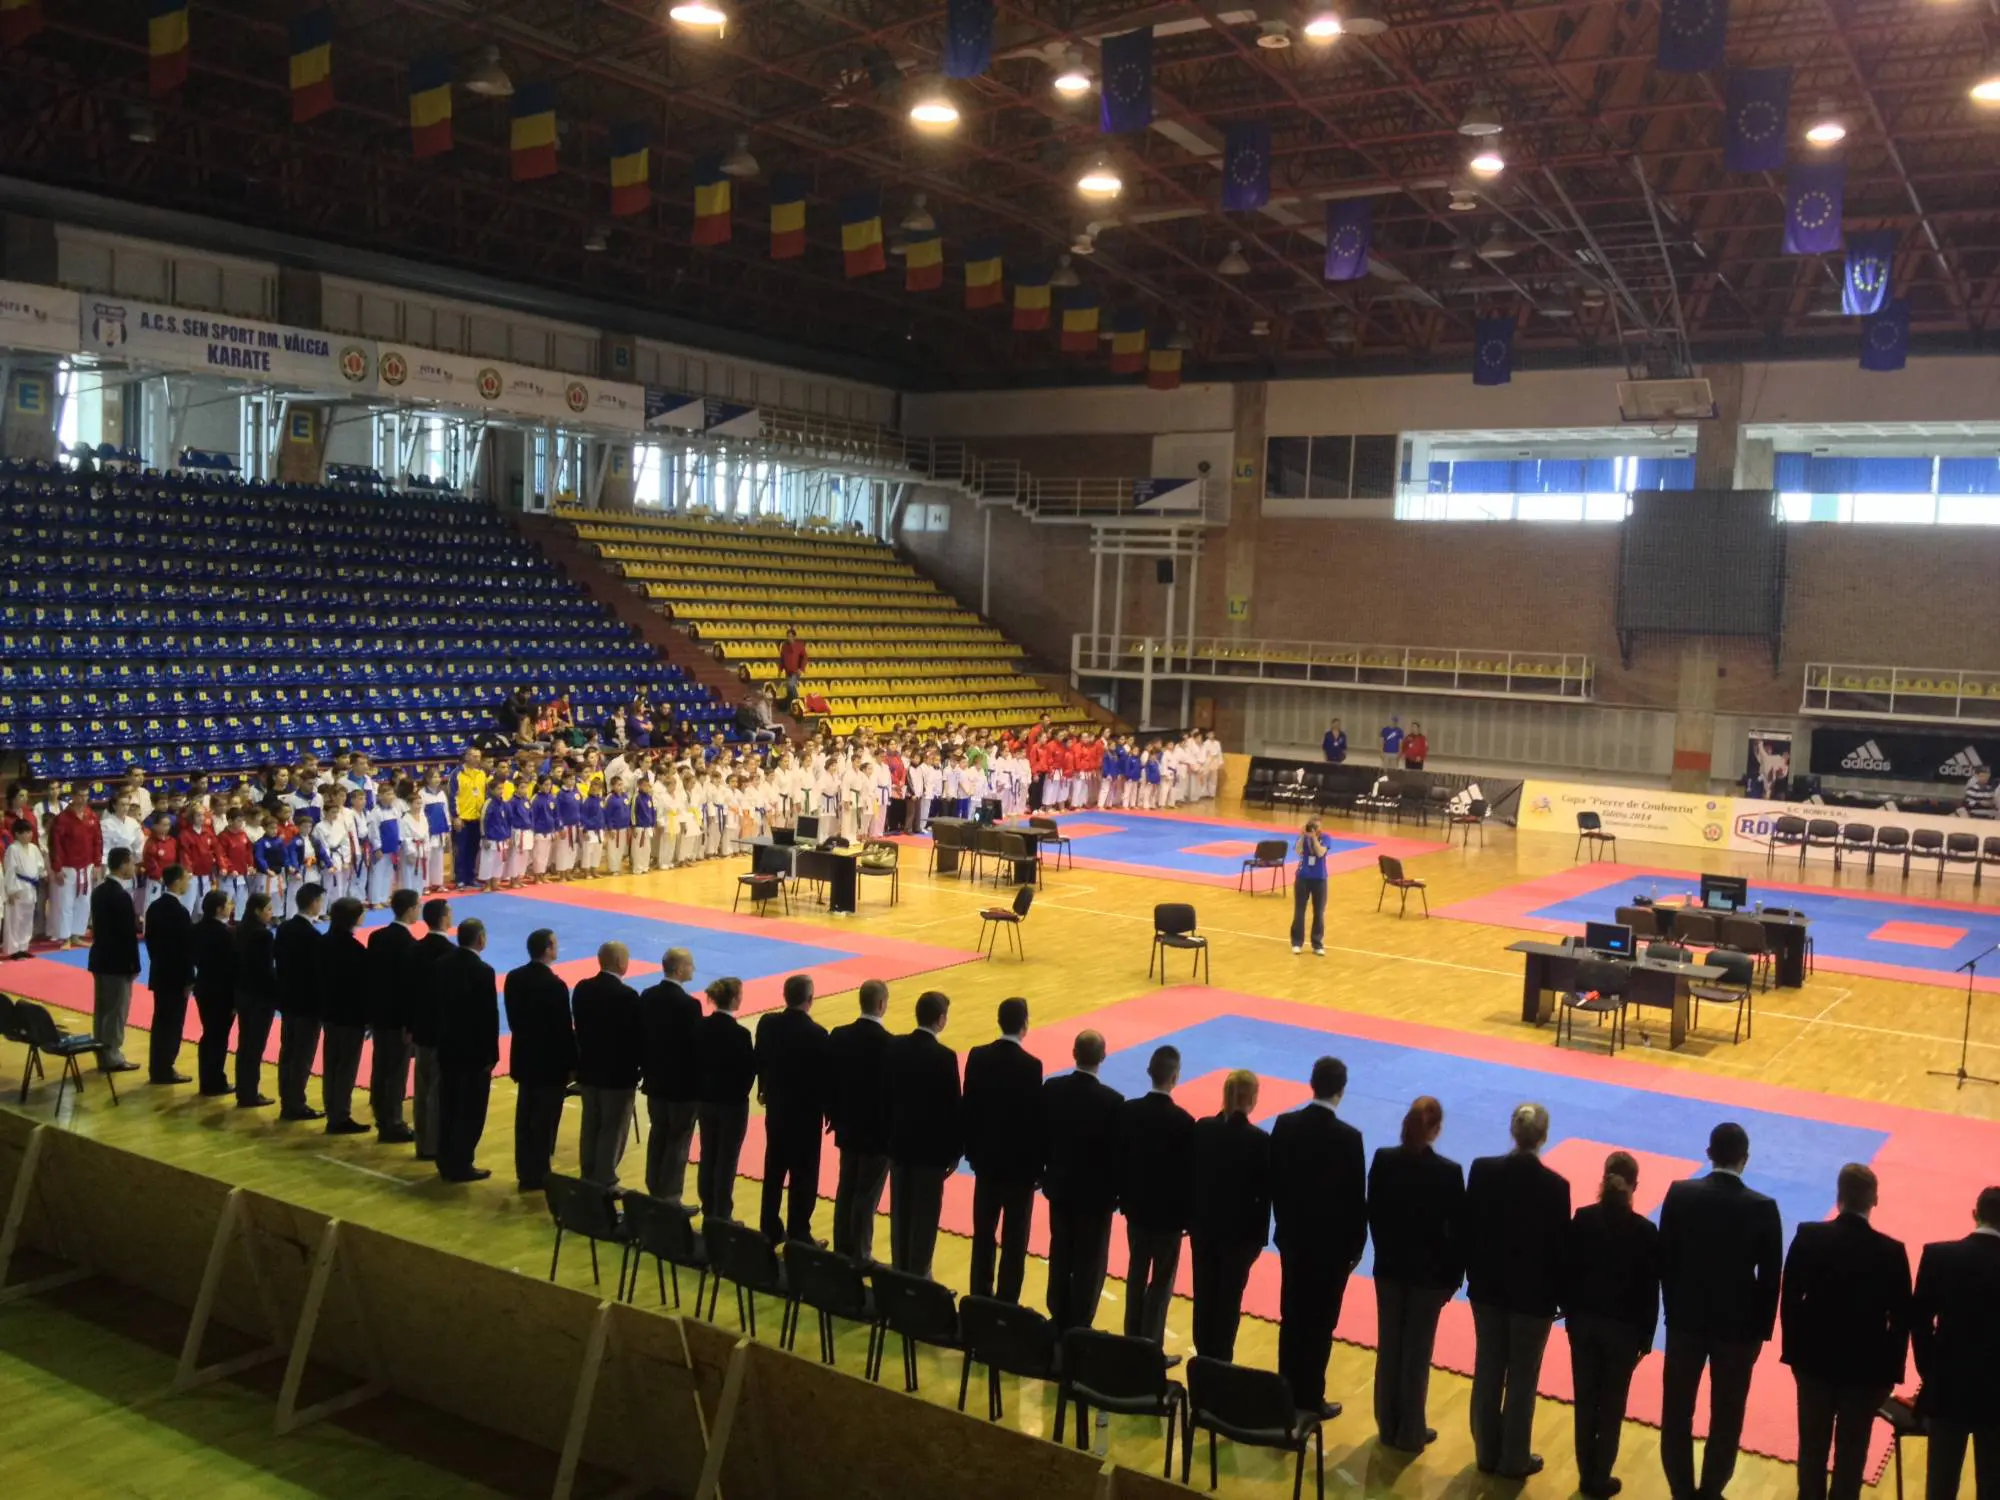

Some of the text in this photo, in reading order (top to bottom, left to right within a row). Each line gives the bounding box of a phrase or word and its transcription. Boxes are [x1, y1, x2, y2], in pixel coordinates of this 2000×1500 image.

[183, 318, 209, 337] SEN
[211, 322, 255, 344] SPORT
[258, 330, 281, 350] RM.
[207, 343, 271, 371] KARATE
[19, 383, 40, 410] E
[292, 415, 310, 439] E
[1230, 601, 1248, 615] L7
[1841, 757, 1892, 772] adidas
[1939, 763, 1977, 777] adid
[1626, 799, 1639, 809] de
